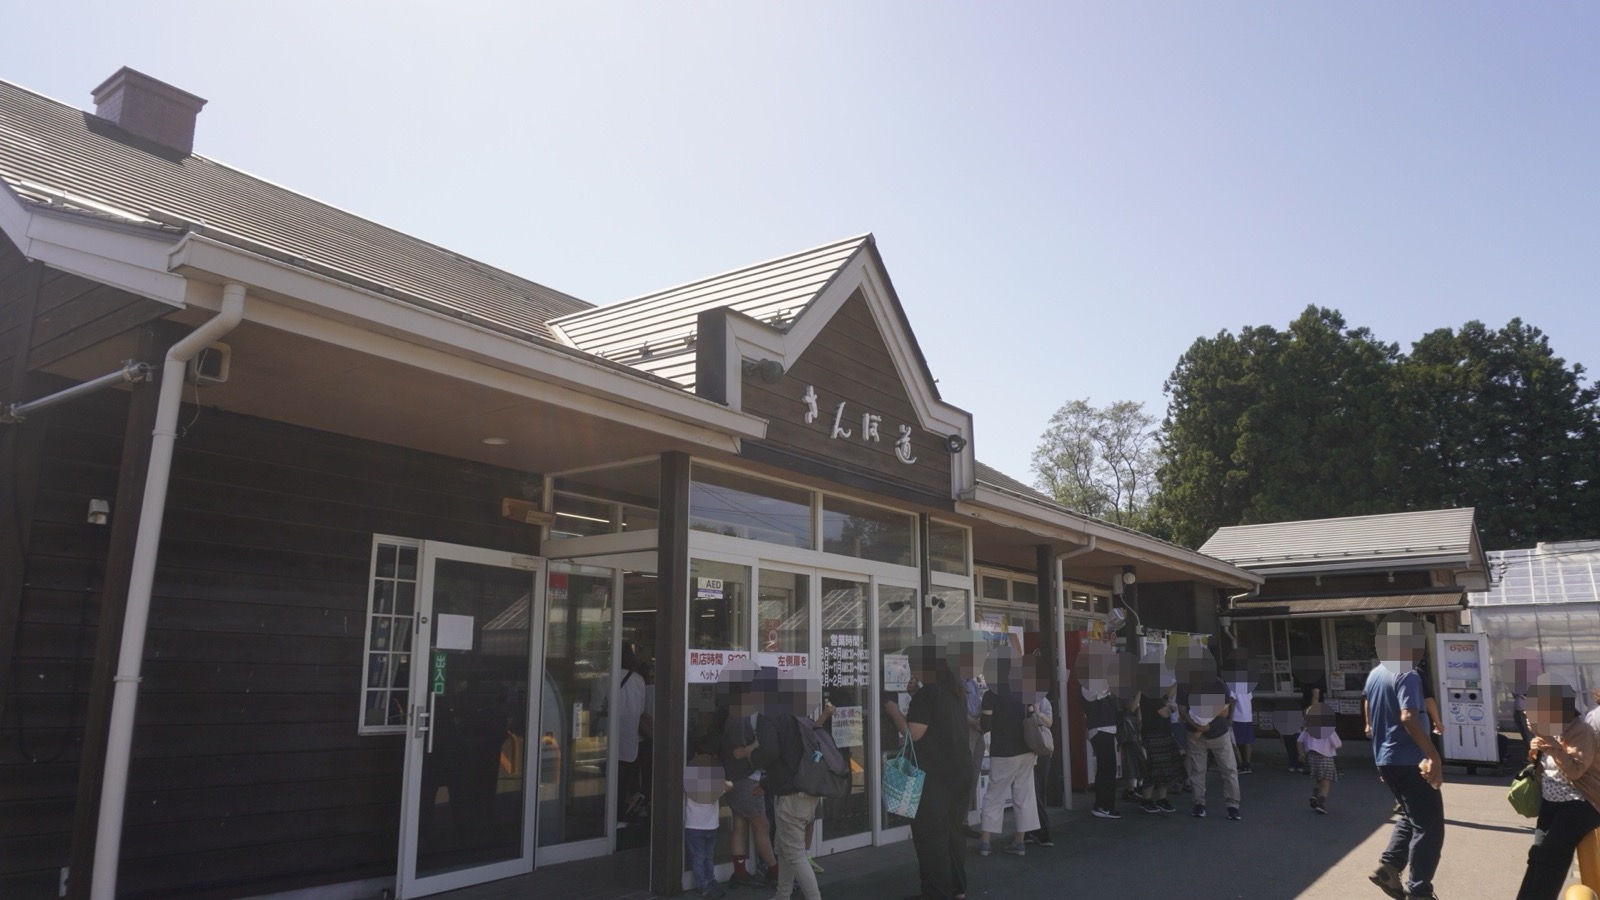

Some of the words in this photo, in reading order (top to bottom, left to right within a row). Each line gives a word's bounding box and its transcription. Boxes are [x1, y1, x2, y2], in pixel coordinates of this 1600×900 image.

[706, 580, 721, 589] AED
[830, 634, 859, 646] 営業時間
[1450, 644, 1475, 652] DyDo
[690, 652, 723, 666] 開店時間
[777, 655, 807, 667] 左側扉を
[434, 655, 446, 694] 出入口
